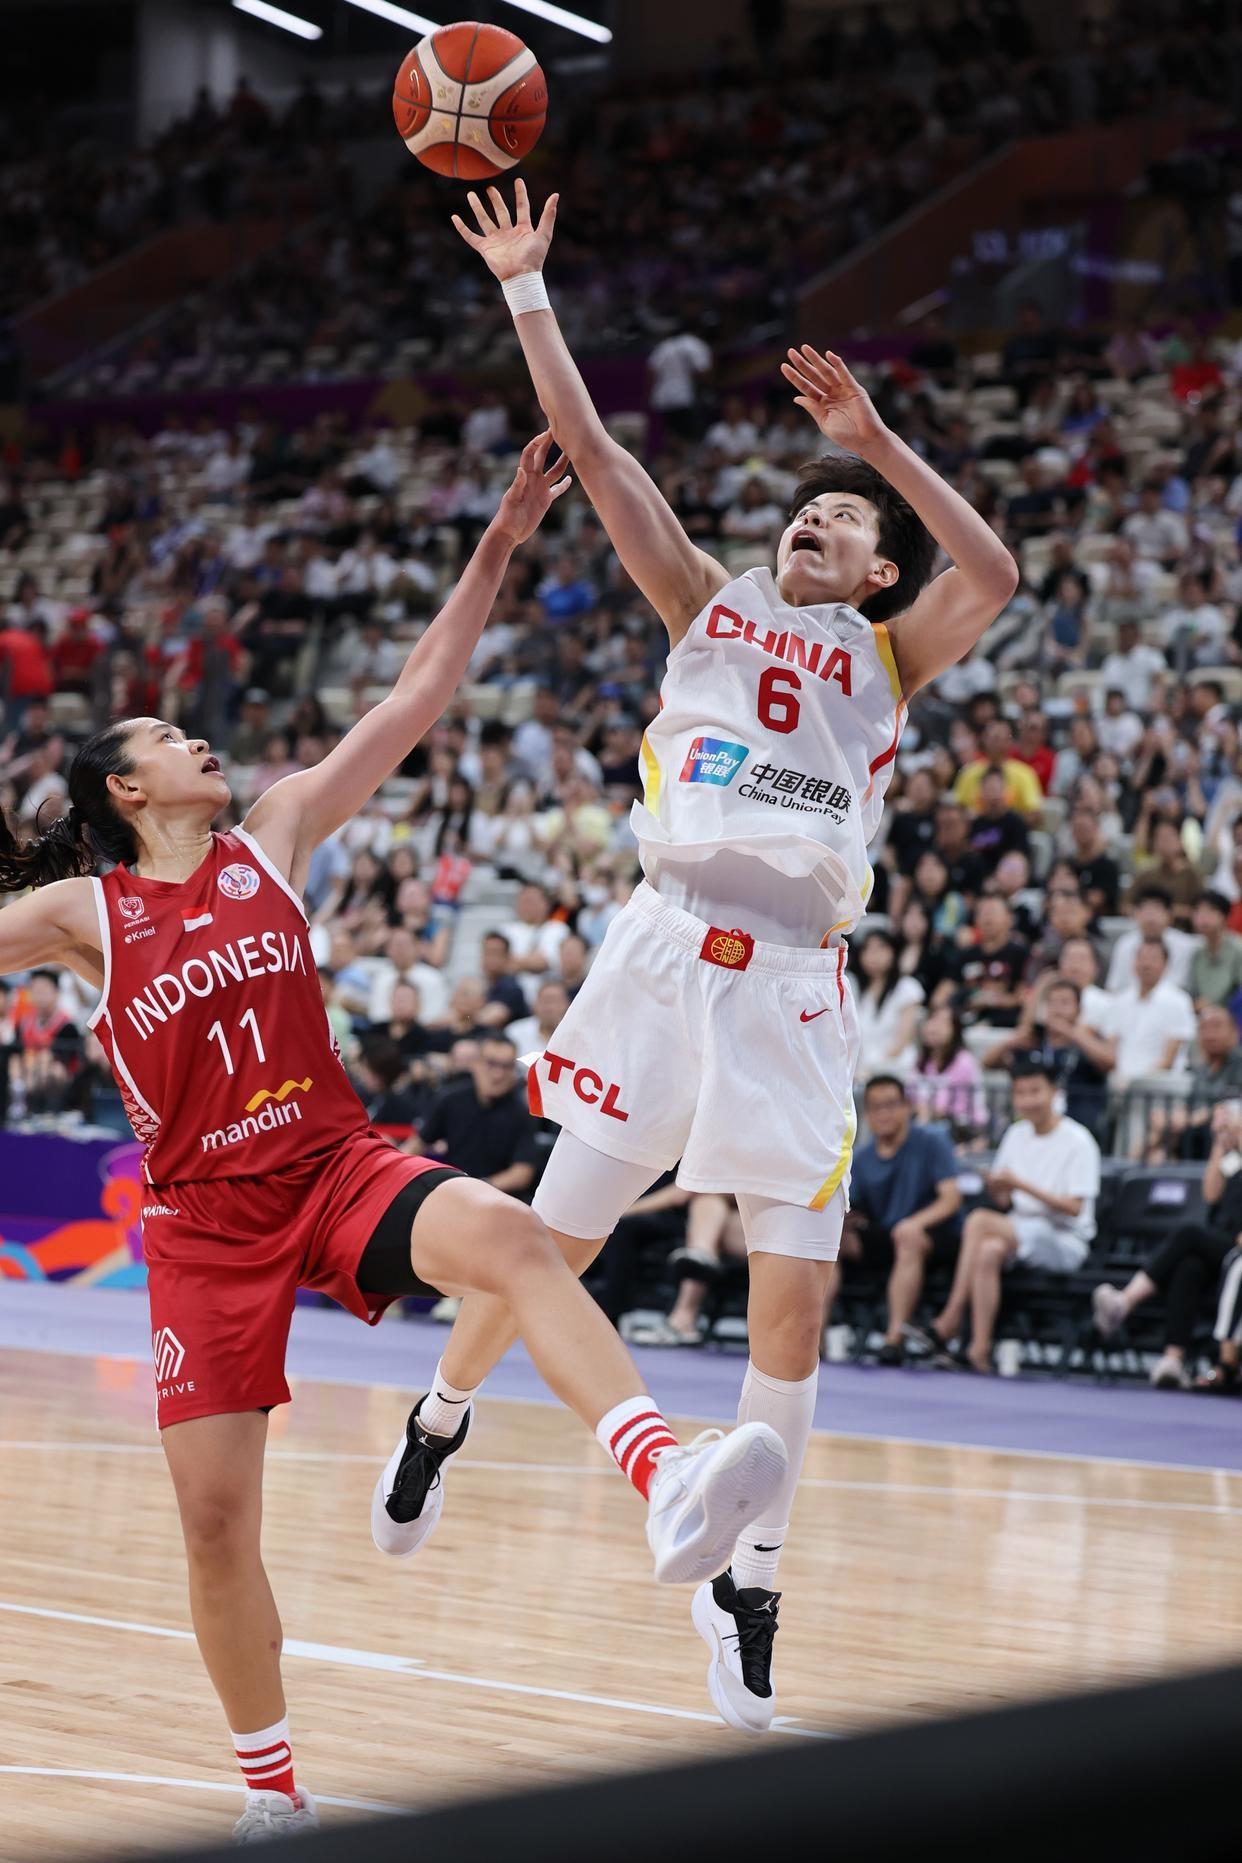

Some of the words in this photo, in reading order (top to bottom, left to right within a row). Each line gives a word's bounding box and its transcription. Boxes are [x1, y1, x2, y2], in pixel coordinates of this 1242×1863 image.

[706, 604, 852, 697] CHINA
[758, 666, 801, 734] 6
[690, 748, 739, 768] UnionPay
[700, 762, 730, 777] 银联
[738, 784, 777, 804] China
[781, 795, 845, 825] UnionPay
[750, 764, 851, 813] 中国银联
[132, 927, 155, 941] Kniel
[125, 931, 306, 1040] INDONESIA
[207, 1008, 265, 1075] 11
[543, 1050, 629, 1122] TCL
[201, 1100, 302, 1152] mandiri
